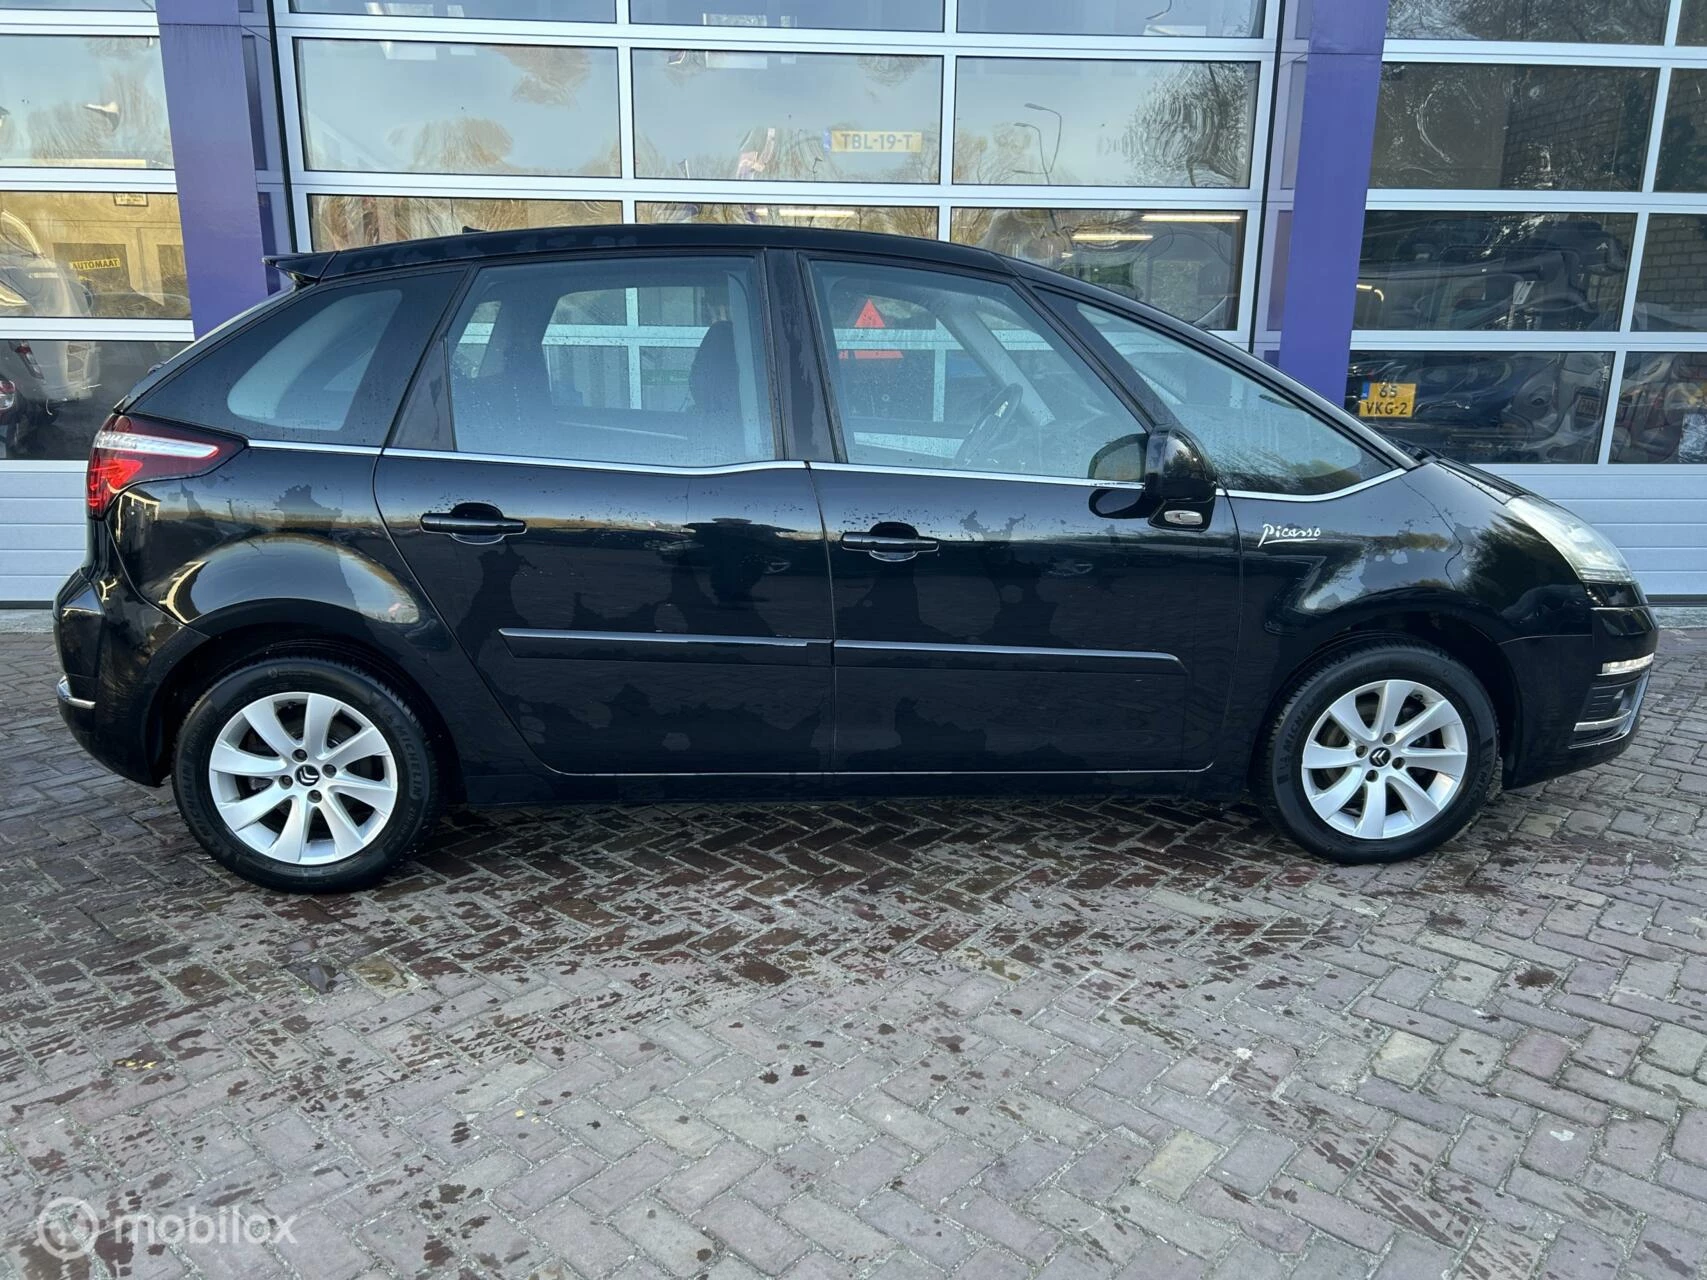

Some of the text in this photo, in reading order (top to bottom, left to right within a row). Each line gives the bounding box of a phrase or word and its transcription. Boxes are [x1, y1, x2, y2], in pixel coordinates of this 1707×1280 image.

[841, 133, 913, 150] TBL-19-T
[72, 259, 119, 271] AUTOMAAT
[1365, 401, 1409, 416] VKG-2
[1257, 523, 1322, 549] Picasso
